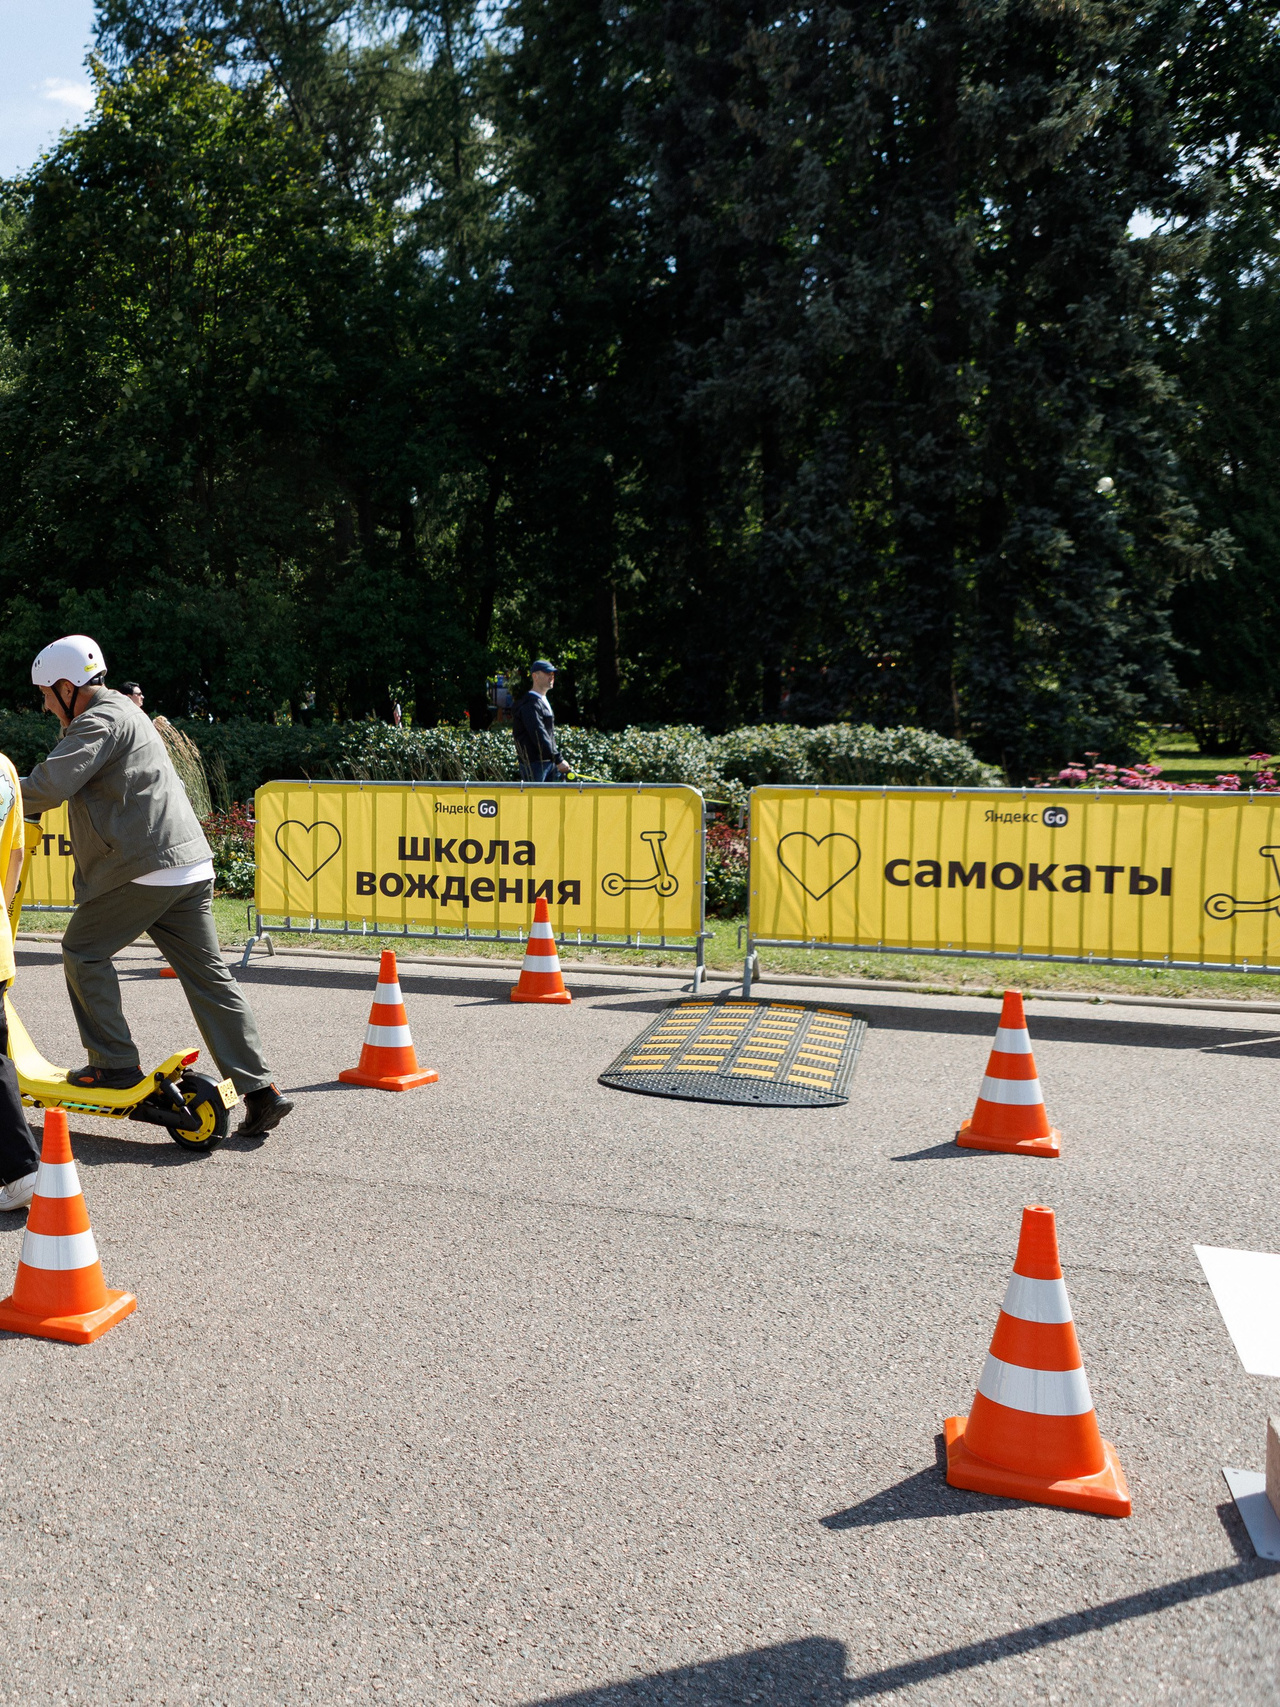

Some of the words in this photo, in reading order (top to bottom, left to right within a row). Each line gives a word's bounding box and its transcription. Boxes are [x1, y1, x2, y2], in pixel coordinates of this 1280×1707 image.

[434, 802, 475, 815] Яндекс
[479, 802, 496, 815] Go
[984, 810, 1038, 824] Яндекс
[1043, 810, 1067, 825] Go
[398, 836, 536, 866] школа
[356, 871, 581, 908] вождения
[884, 858, 1173, 897] самокаты
